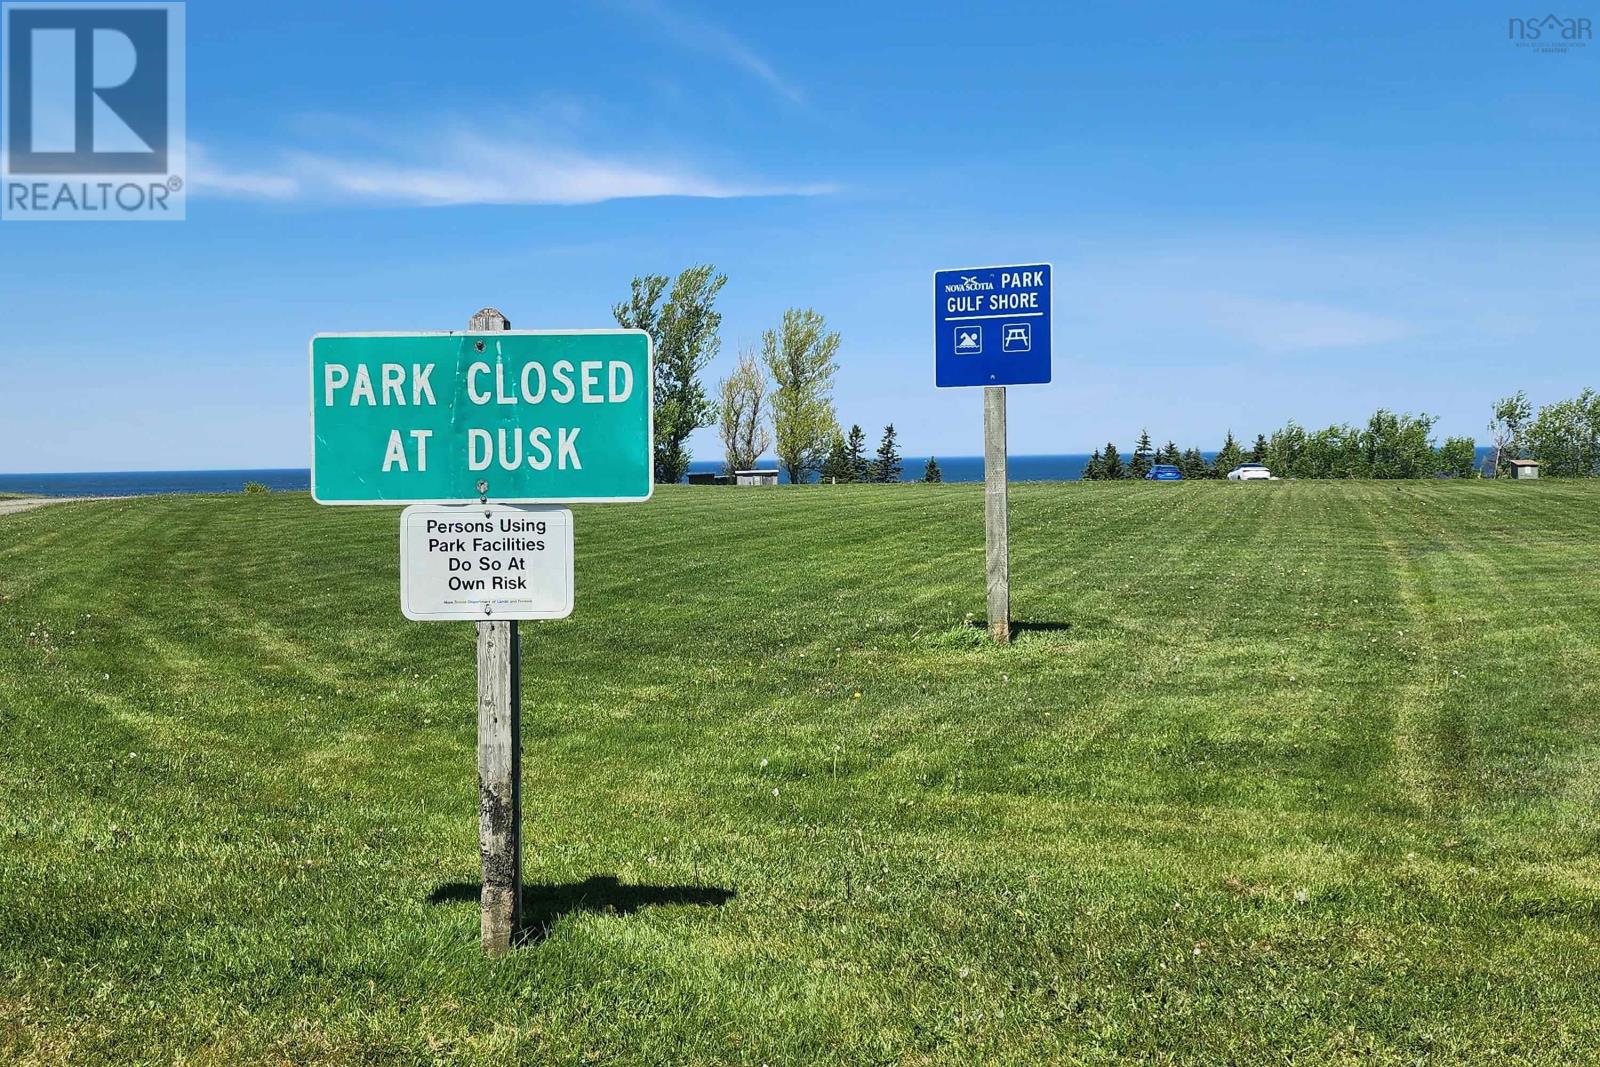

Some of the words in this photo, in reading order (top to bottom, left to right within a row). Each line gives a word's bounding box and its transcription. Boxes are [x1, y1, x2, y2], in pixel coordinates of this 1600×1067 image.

[1001, 271, 1043, 288] PARK
[947, 295, 984, 312] GULF
[989, 292, 1039, 310] SHORE
[324, 363, 437, 406] PARK
[467, 360, 634, 404] CLOSED
[381, 429, 432, 472] AT
[468, 427, 582, 471] DUSK
[426, 519, 494, 533] Persons
[500, 519, 546, 534] Using
[428, 539, 466, 552] Park
[473, 537, 545, 551] Facilities
[449, 557, 472, 571] Do
[479, 557, 502, 571] So
[508, 557, 525, 570] At
[448, 576, 485, 590] Own
[492, 576, 527, 589] Risk
